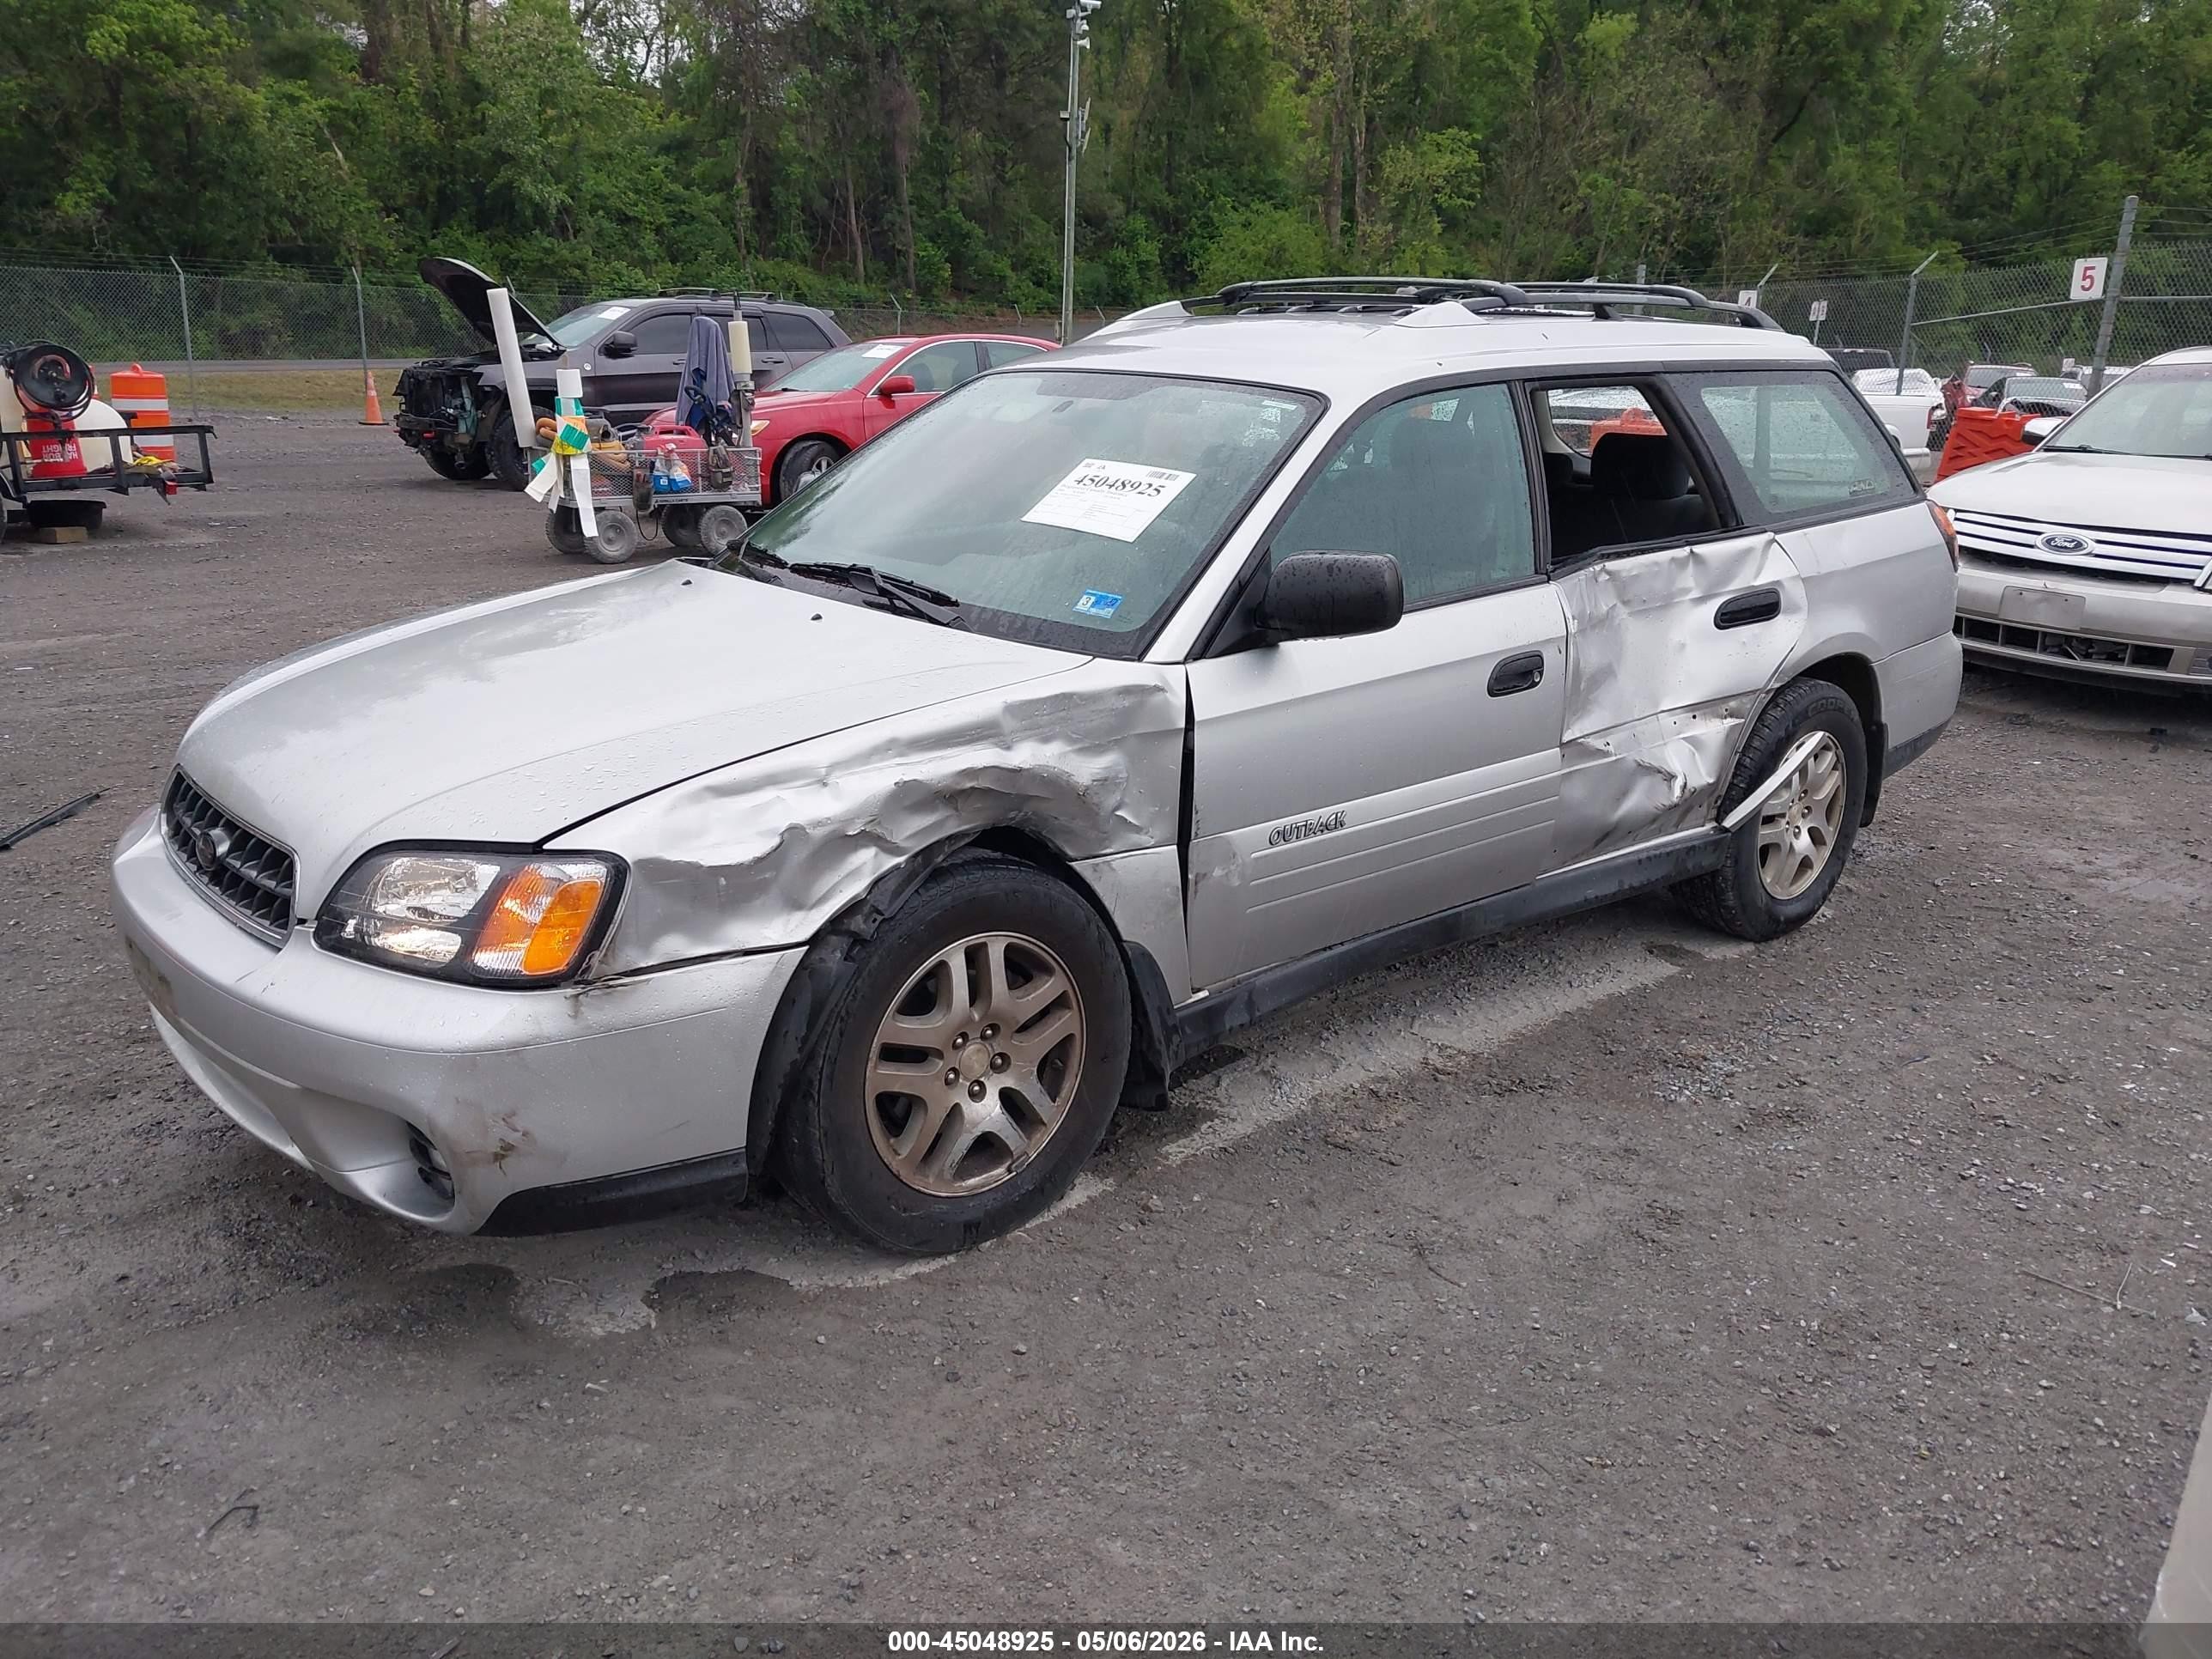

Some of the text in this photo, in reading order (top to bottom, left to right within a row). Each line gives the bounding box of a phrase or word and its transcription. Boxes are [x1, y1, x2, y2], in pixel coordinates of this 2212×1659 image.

[2080, 264, 2095, 293] 5
[42, 452, 79, 460] HABOR
[1073, 473, 1167, 497] 45048925
[2051, 536, 2077, 550] Ford
[1082, 596, 1091, 606] 3
[1269, 810, 1346, 846] OUTBACK
